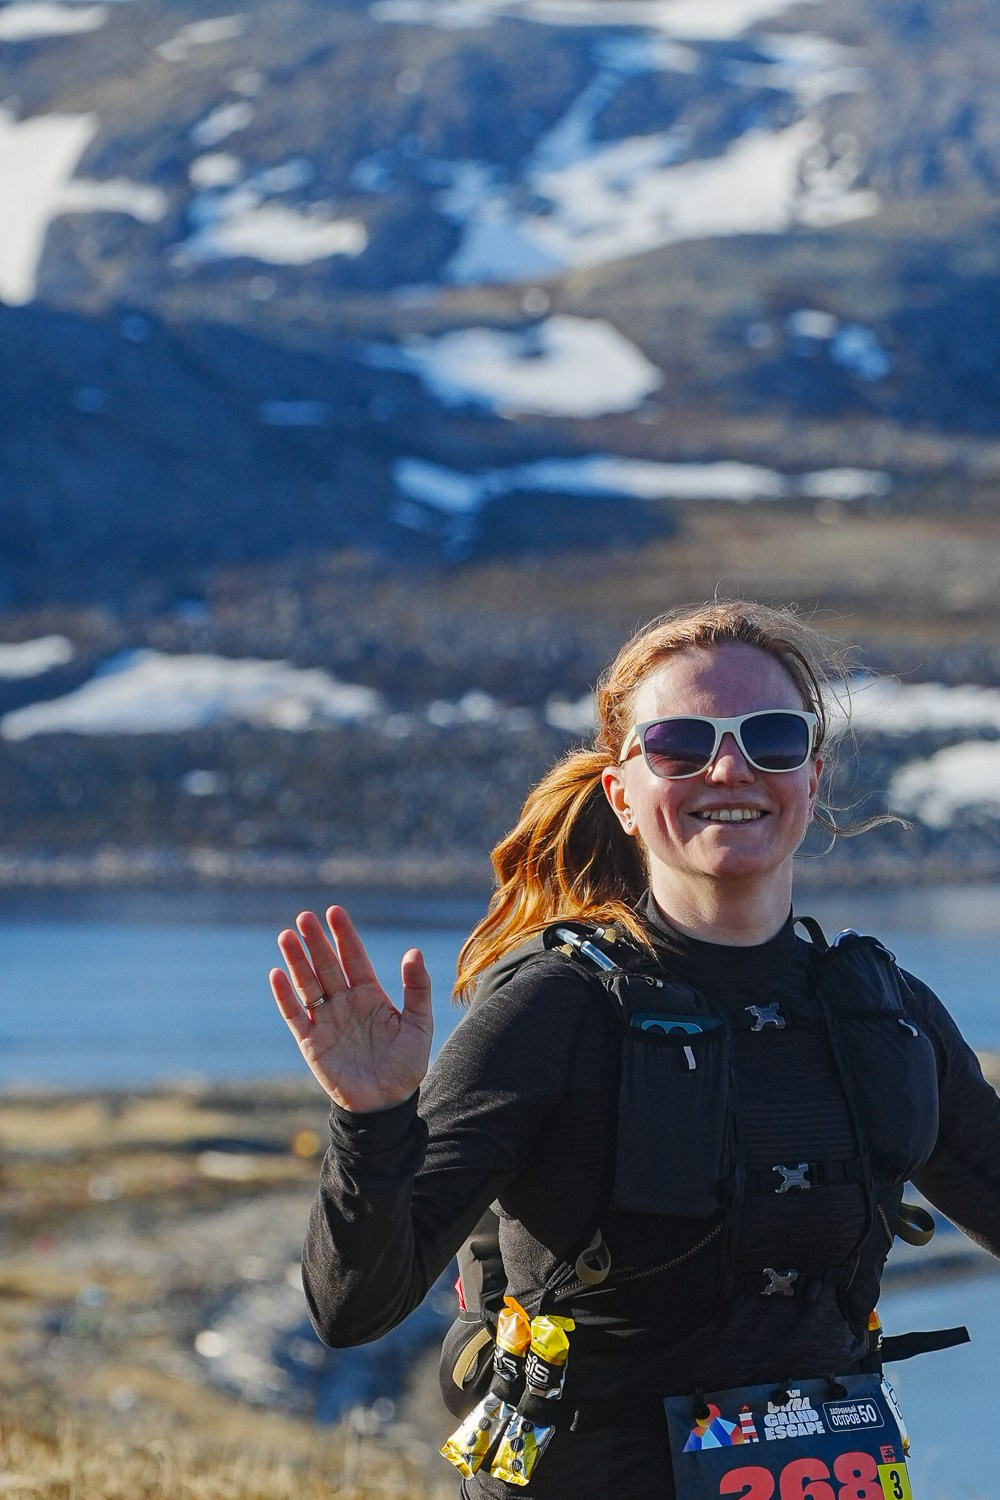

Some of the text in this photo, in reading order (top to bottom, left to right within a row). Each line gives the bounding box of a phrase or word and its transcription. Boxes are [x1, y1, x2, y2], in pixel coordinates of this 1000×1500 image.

[763, 1410, 819, 1428] GRAND
[831, 1404, 877, 1427] ОСТРОВ 50
[764, 1421, 826, 1441] ESCAPE
[889, 1470, 904, 1500] 3
